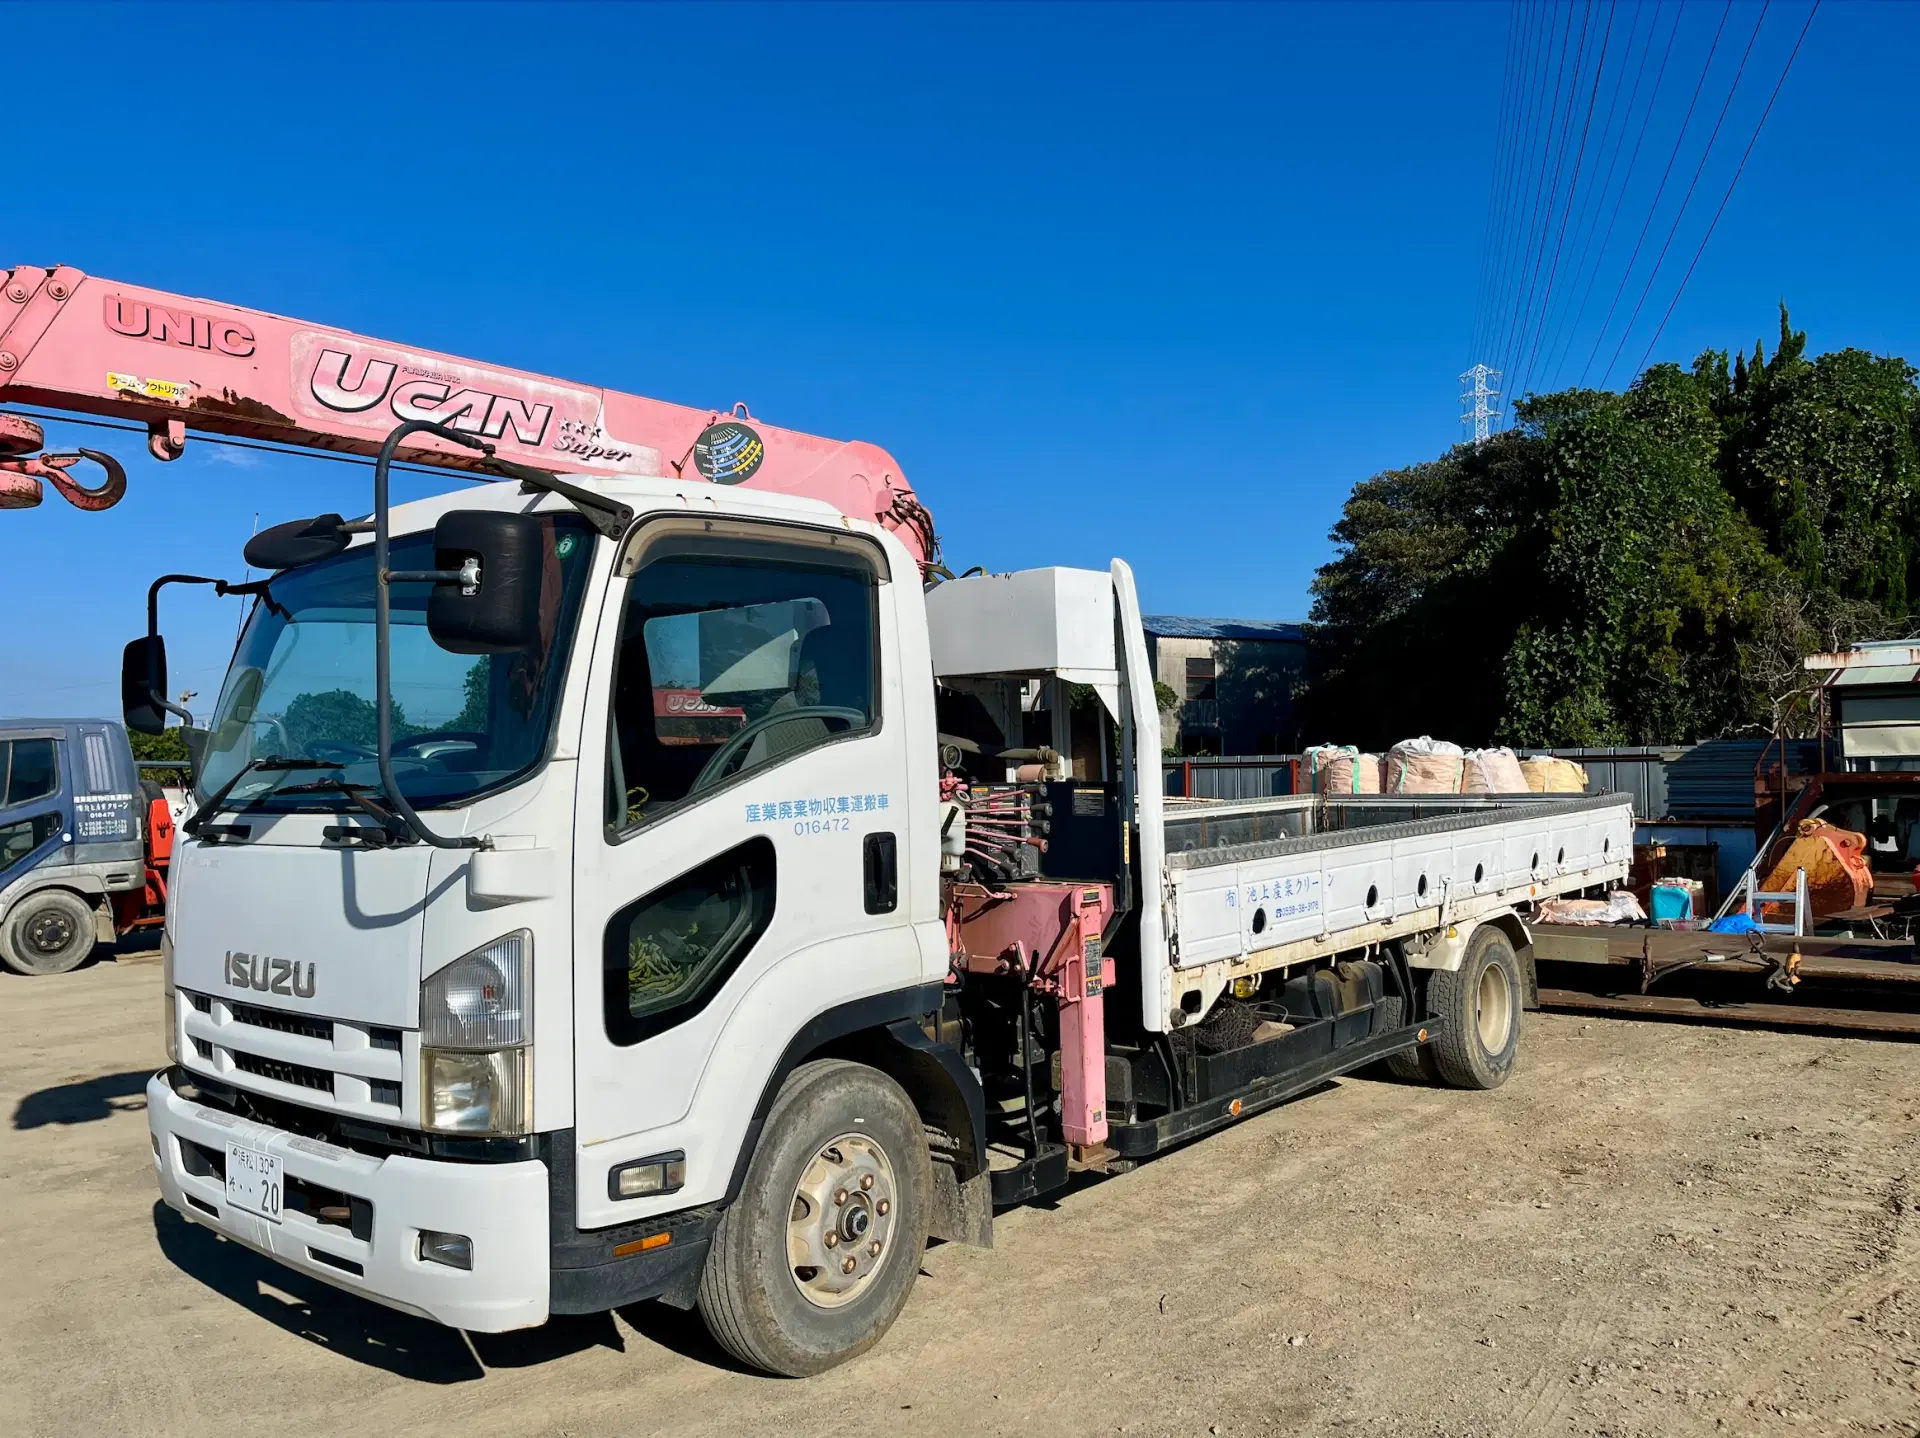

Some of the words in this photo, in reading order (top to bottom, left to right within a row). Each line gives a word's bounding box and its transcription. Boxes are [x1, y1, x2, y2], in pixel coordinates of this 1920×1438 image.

[103, 295, 256, 358] UNIC
[310, 349, 553, 447] UCAN
[551, 433, 632, 462] Super
[745, 793, 889, 823] 産業廃棄物収集運搬車
[794, 817, 850, 836] 016472
[224, 950, 316, 999] ISUZU
